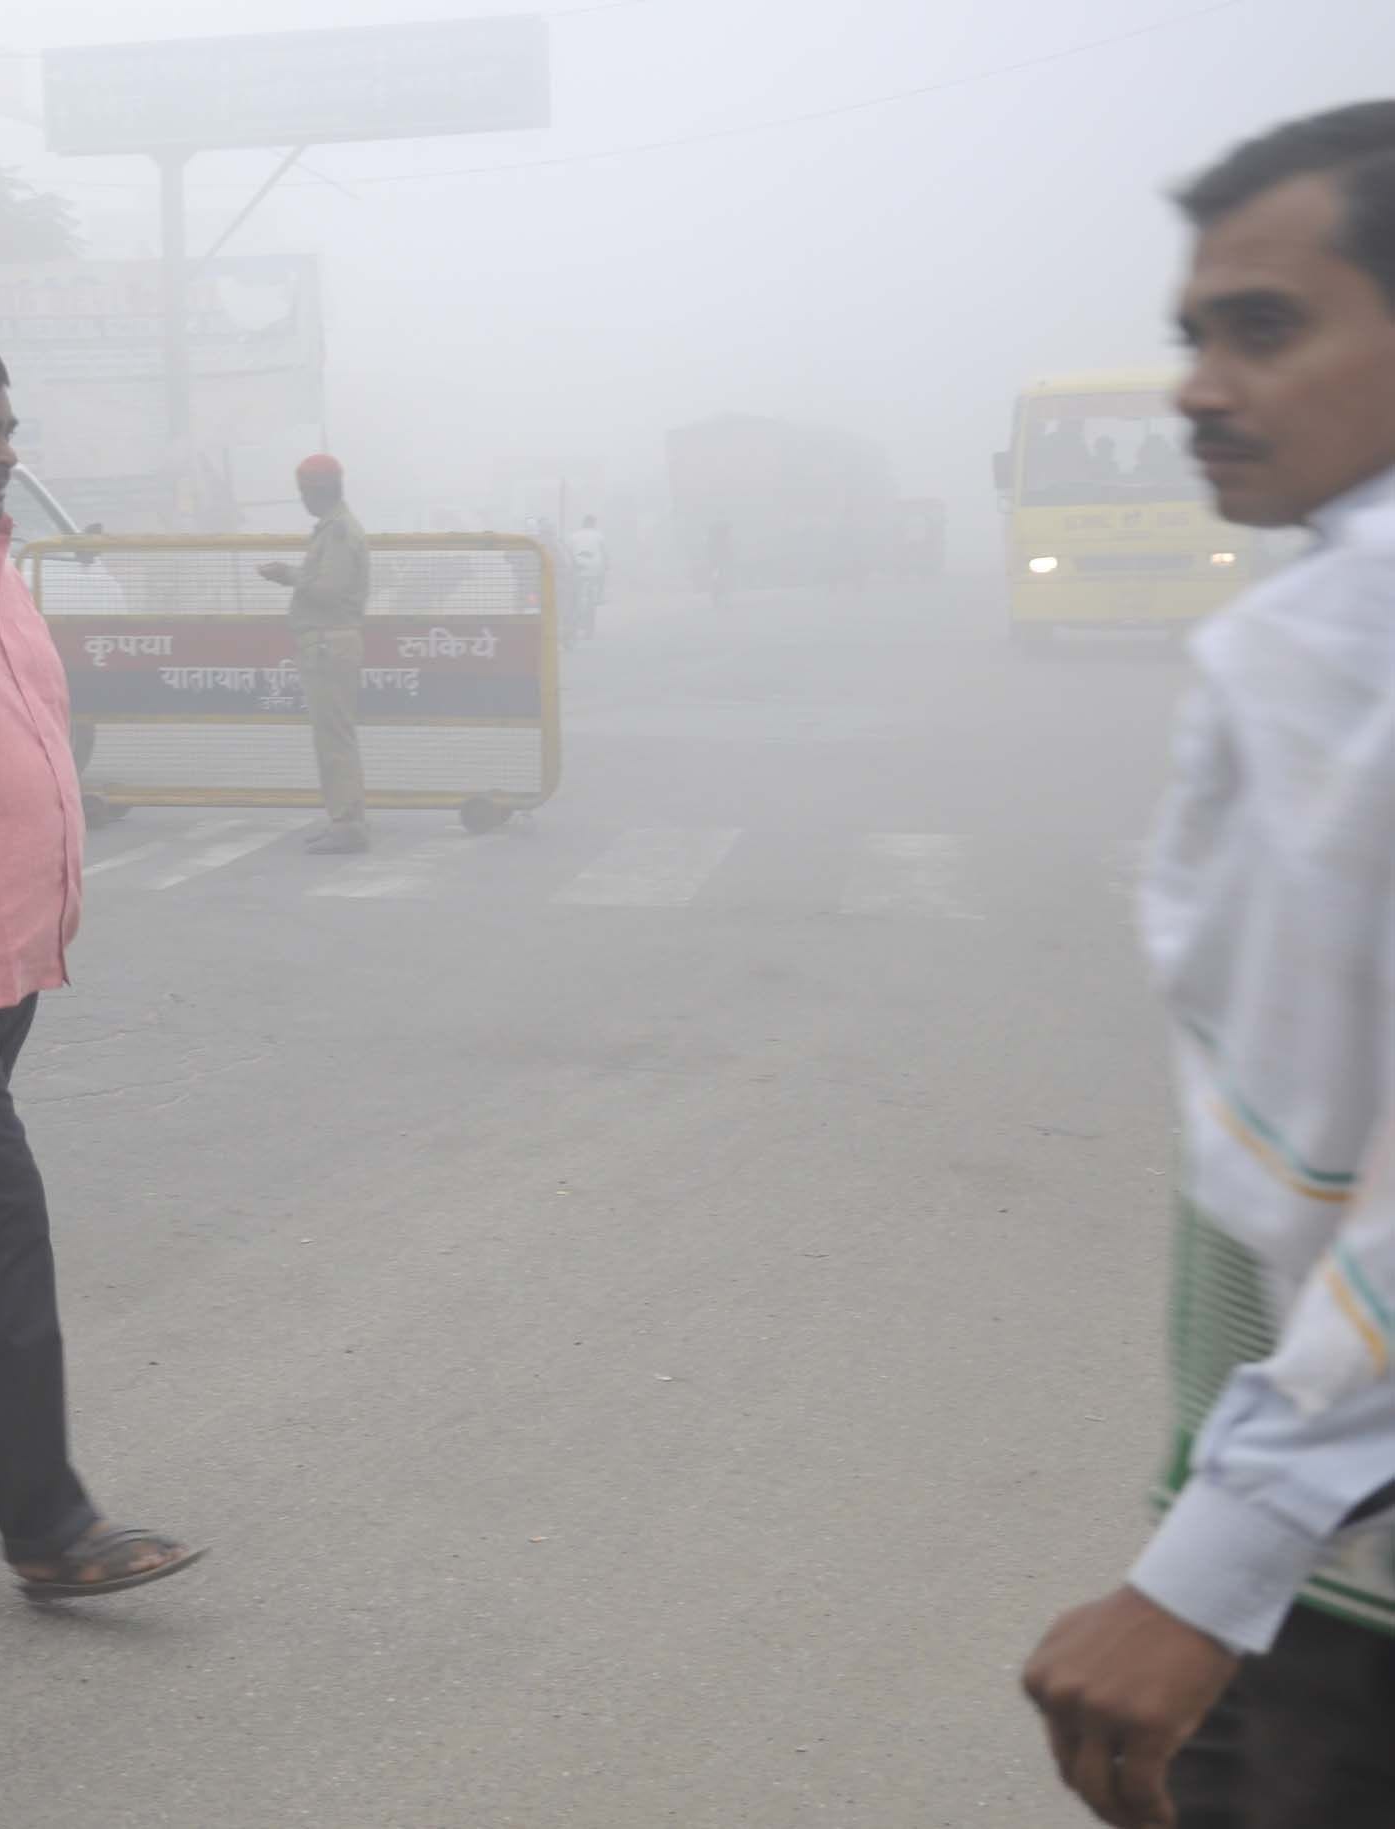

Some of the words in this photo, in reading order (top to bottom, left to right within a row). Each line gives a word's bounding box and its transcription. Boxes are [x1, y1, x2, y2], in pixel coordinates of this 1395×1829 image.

[84, 635, 174, 667] कृपया
[158, 667, 257, 694] यातायात
[259, 658, 301, 697] पुलि
